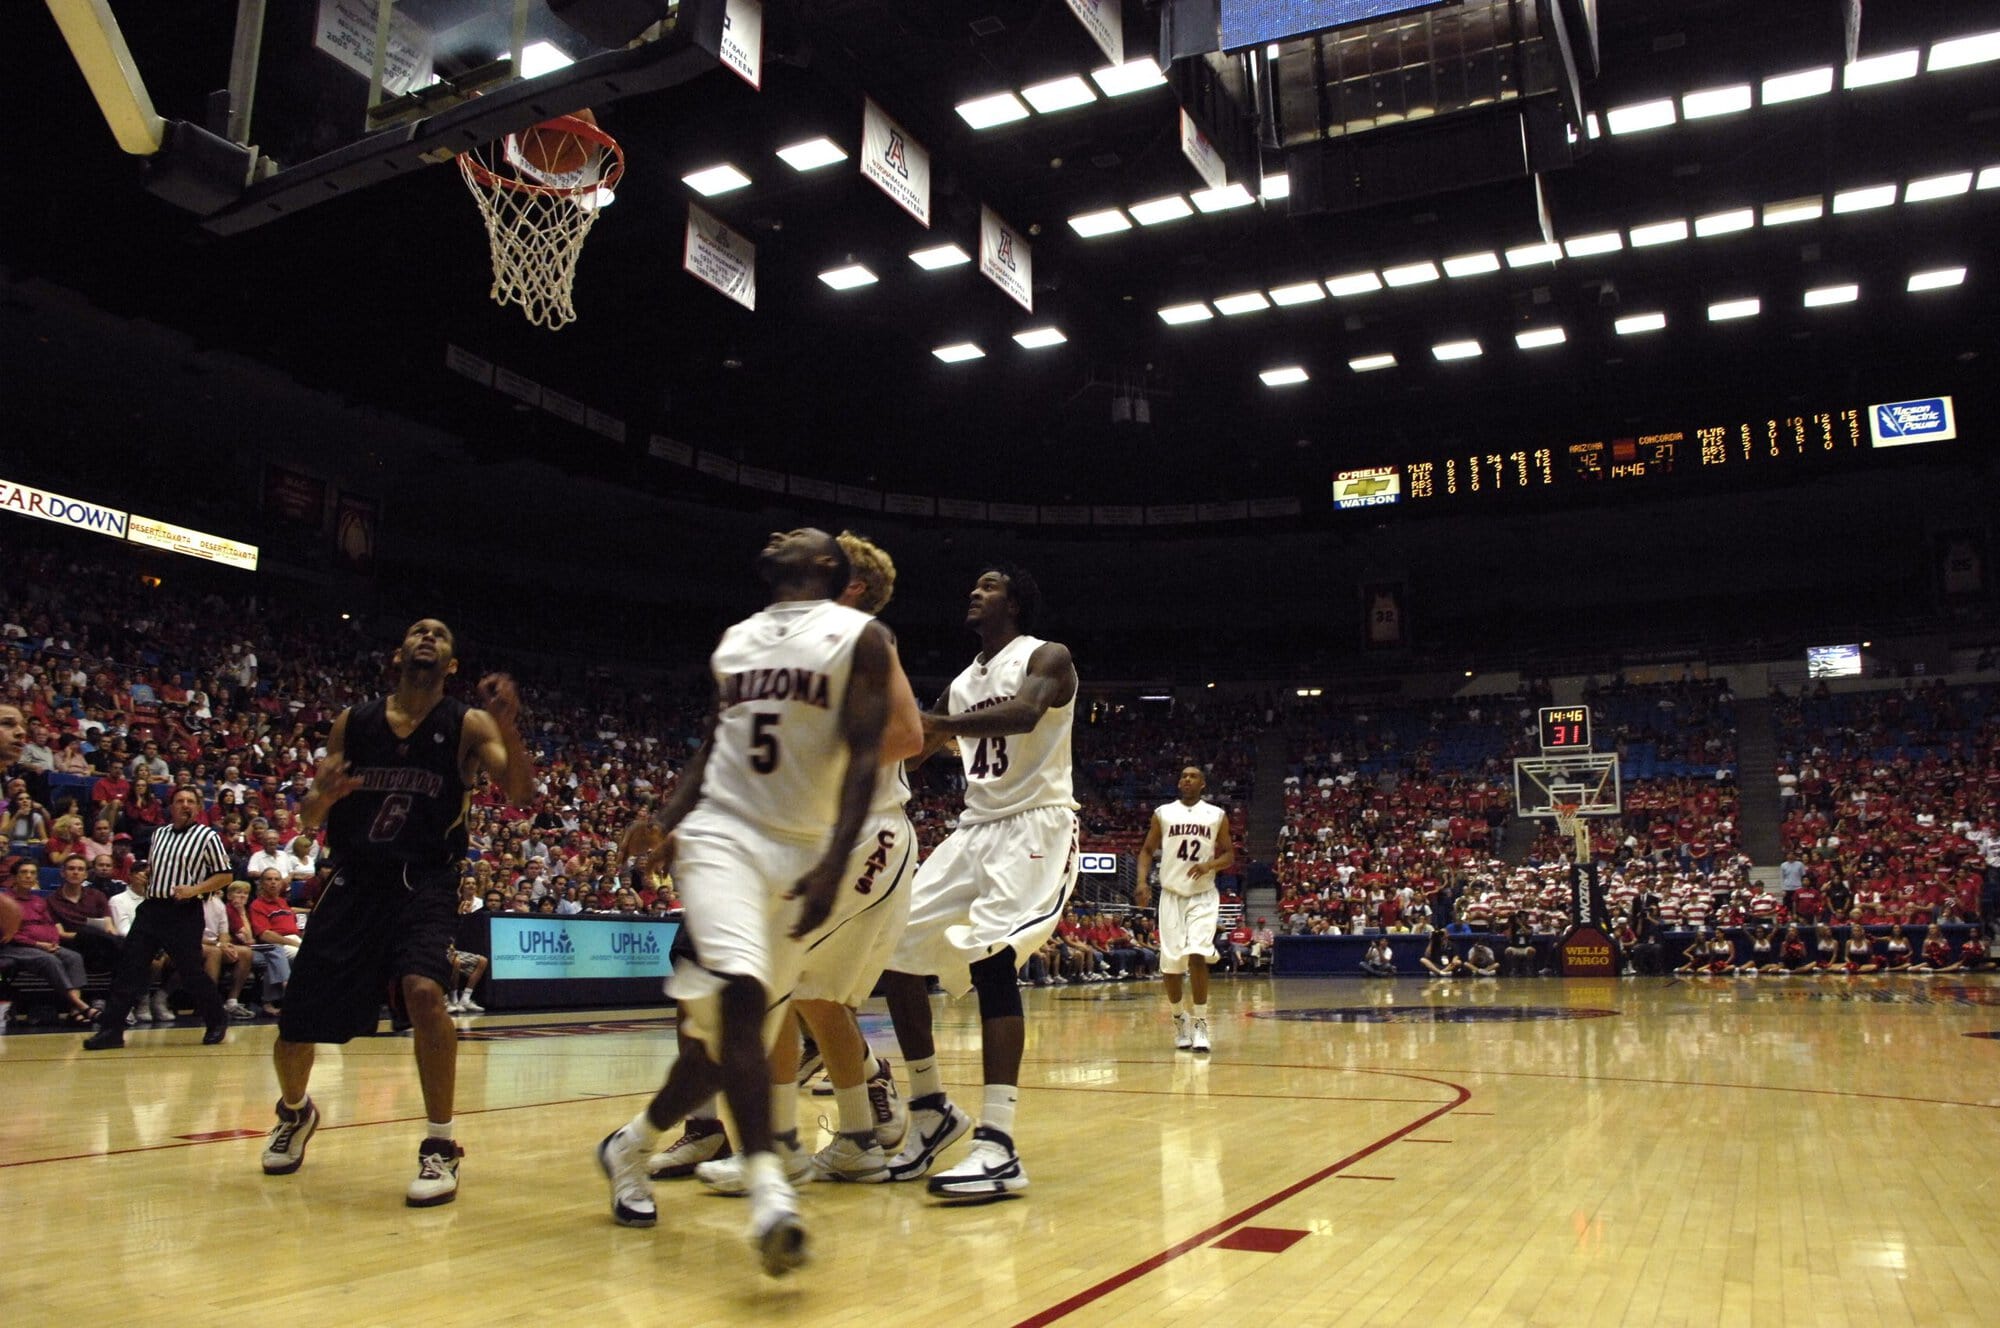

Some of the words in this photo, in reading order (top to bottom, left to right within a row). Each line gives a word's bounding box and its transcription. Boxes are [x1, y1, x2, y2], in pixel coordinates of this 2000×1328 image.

[1813, 412, 1831, 424] 12
[1841, 409, 1858, 420] 15
[1892, 404, 1931, 416] Tucson
[1898, 410, 1941, 424] Electric
[1702, 435, 1723, 447] PTS
[1849, 418, 1859, 428] 4
[1902, 420, 1942, 431] Power
[1702, 444, 1726, 457] RBS
[1823, 431, 1832, 441] 4
[1850, 427, 1860, 438] 2
[1486, 454, 1502, 464] 34
[1510, 451, 1526, 461] 42
[1534, 448, 1550, 458] 43
[1580, 453, 1598, 466] 42
[1655, 444, 1674, 459] 27
[1702, 453, 1727, 465] FLS
[1770, 447, 1779, 457] 0
[1824, 440, 1833, 450] 0
[1338, 466, 1393, 480] O'RIELLY
[1411, 479, 1432, 490] RBS
[1543, 466, 1551, 475] 4
[1412, 471, 1430, 481] PTS
[1611, 462, 1645, 479] 14:46
[1447, 485, 1456, 494] 0
[1471, 482, 1480, 491] 0
[1519, 477, 1528, 487] 0
[1543, 474, 1552, 484] 2
[1339, 495, 1396, 510] WATSON
[1375, 610, 1394, 623] 32
[1549, 709, 1584, 724] 14:46
[749, 712, 781, 775] 5
[1552, 725, 1579, 745] 31
[968, 736, 1009, 780] 43
[368, 792, 413, 842] 6
[1168, 823, 1212, 840] ARIZONA
[1176, 839, 1201, 862] 42
[854, 829, 896, 896] CATS
[1578, 867, 1592, 924] ARIZONA
[519, 930, 555, 954] UPH
[611, 932, 642, 954] UPH
[1565, 946, 1610, 956] WELLS
[1567, 956, 1610, 966] FARGO
